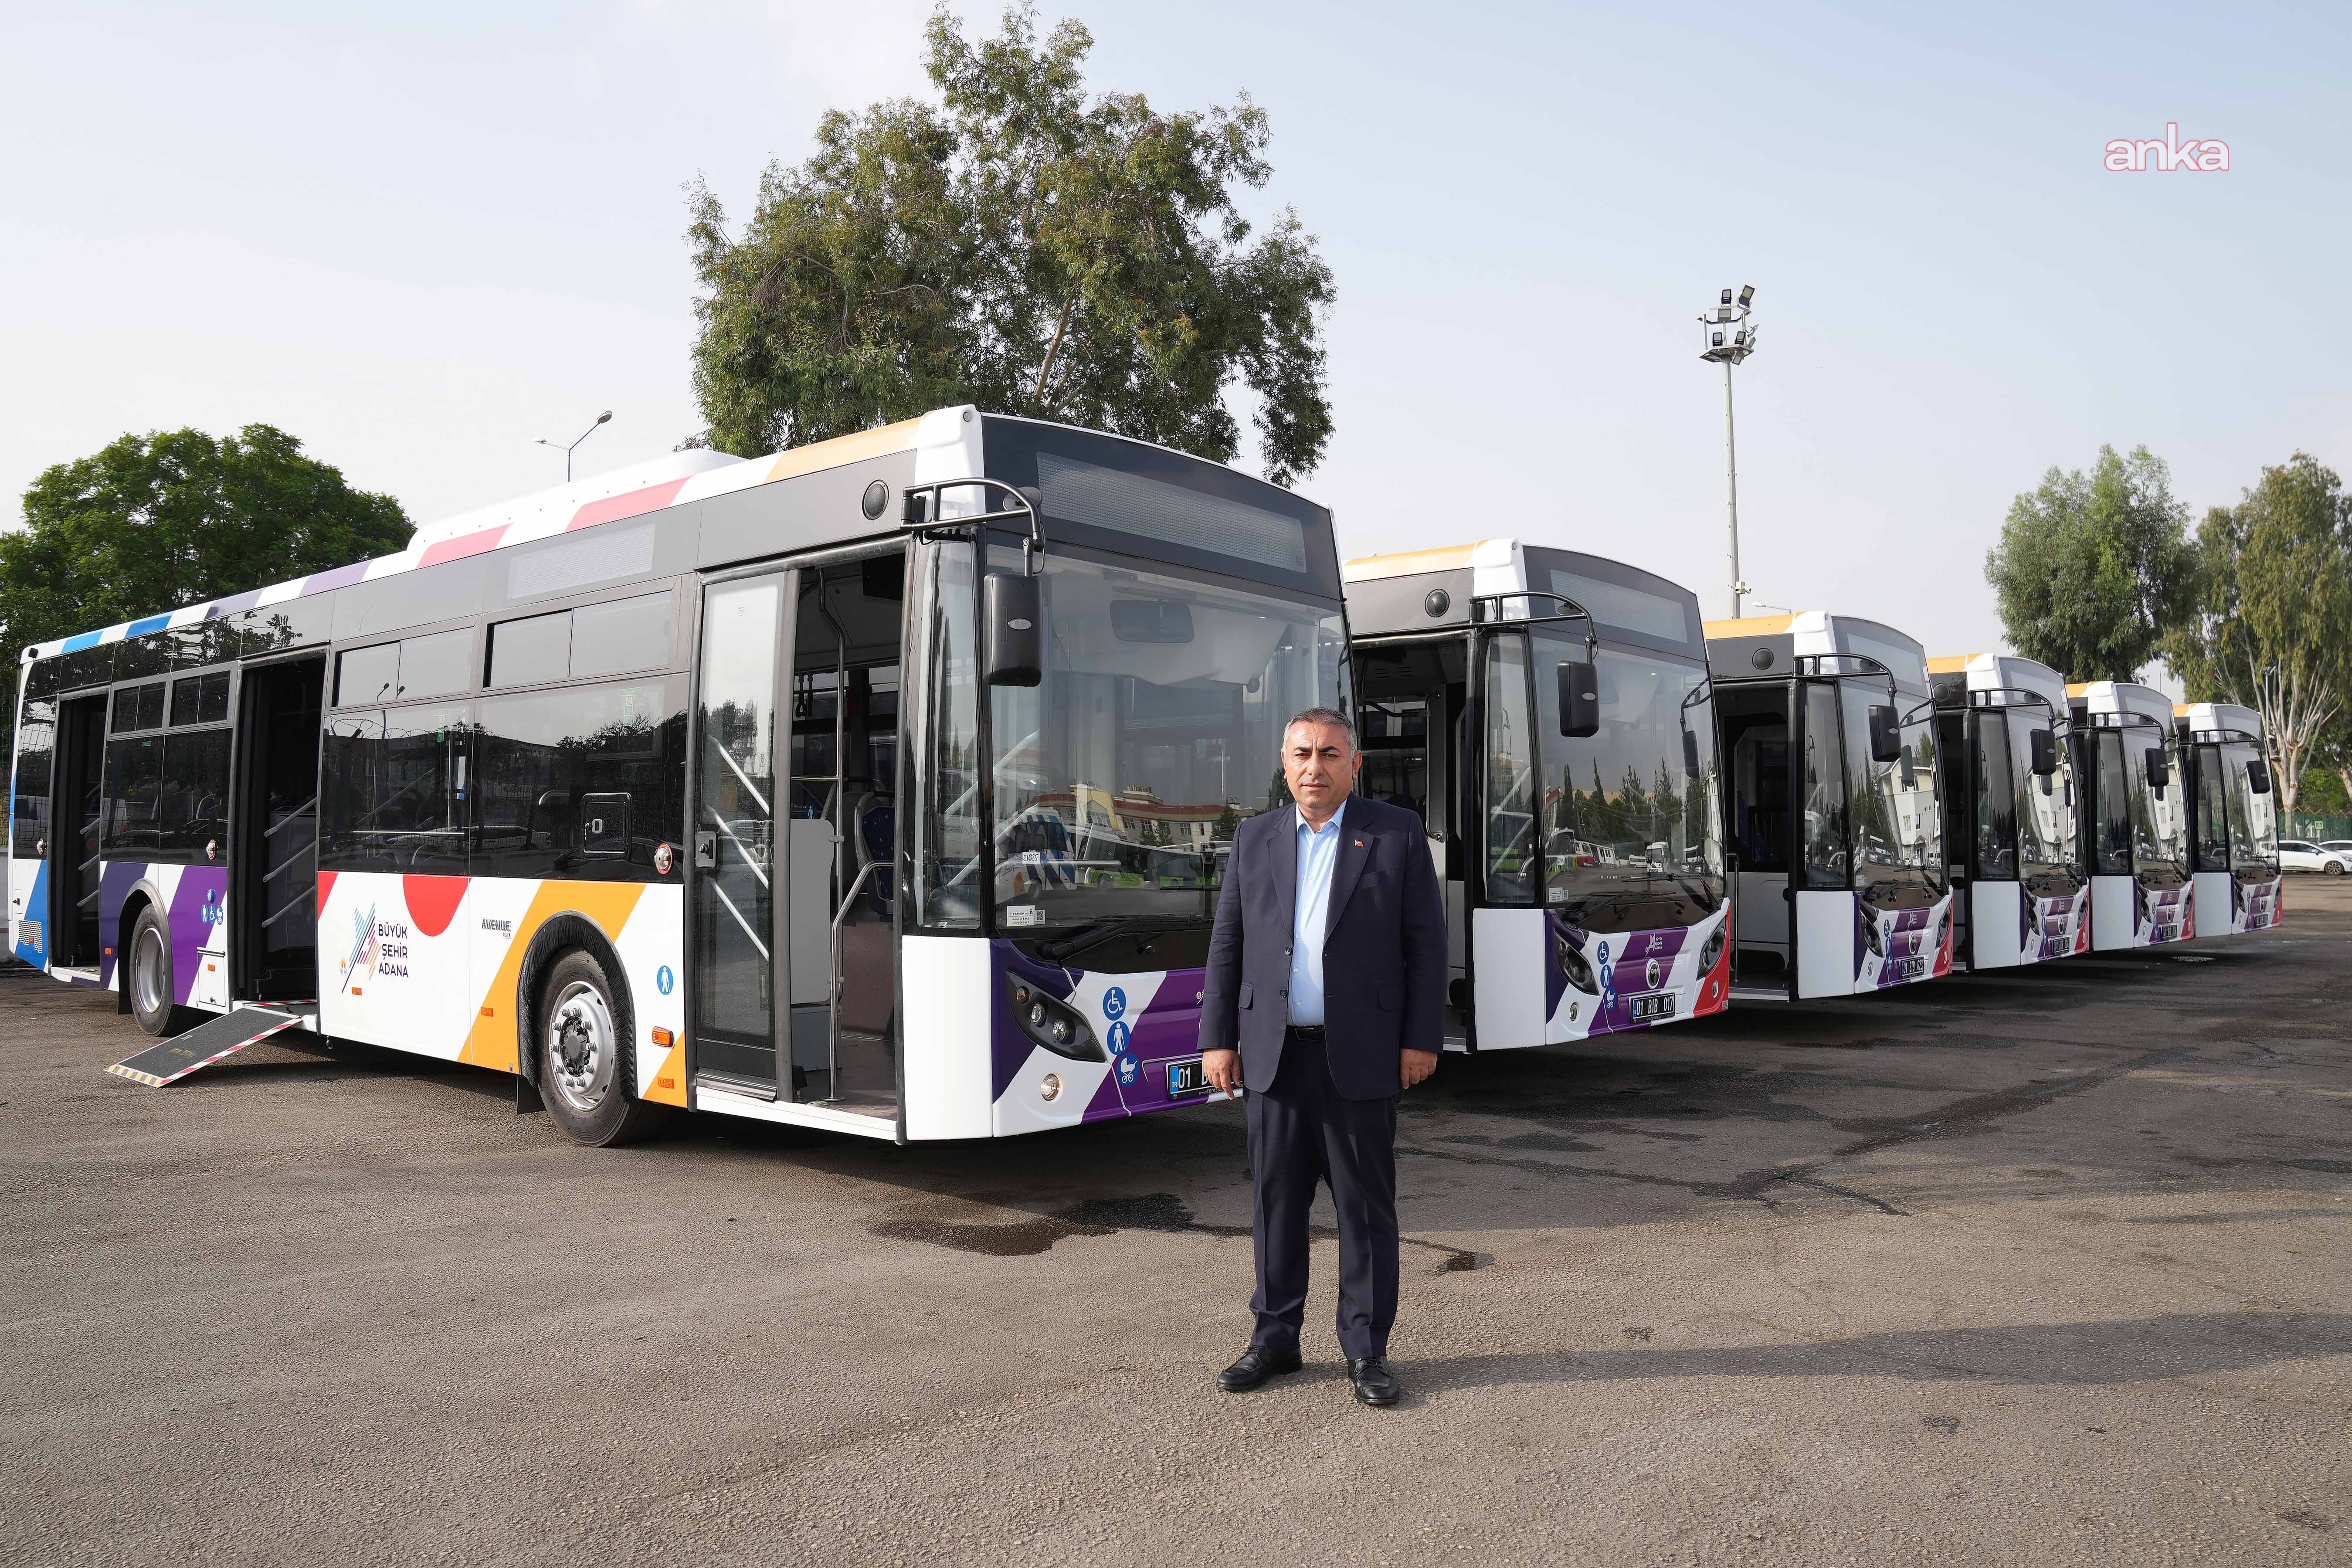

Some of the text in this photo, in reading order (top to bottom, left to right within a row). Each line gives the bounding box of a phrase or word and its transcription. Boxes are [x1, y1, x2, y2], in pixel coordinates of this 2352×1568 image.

[378, 922, 407, 939] BÜYÜK
[482, 919, 511, 932] AVENUE
[382, 942, 408, 960] ŞEHİR
[379, 962, 408, 978] ADANA
[1904, 962, 1907, 974] 01
[1636, 996, 1673, 1015] 01 BIB 017
[1178, 1067, 1191, 1089] 01
